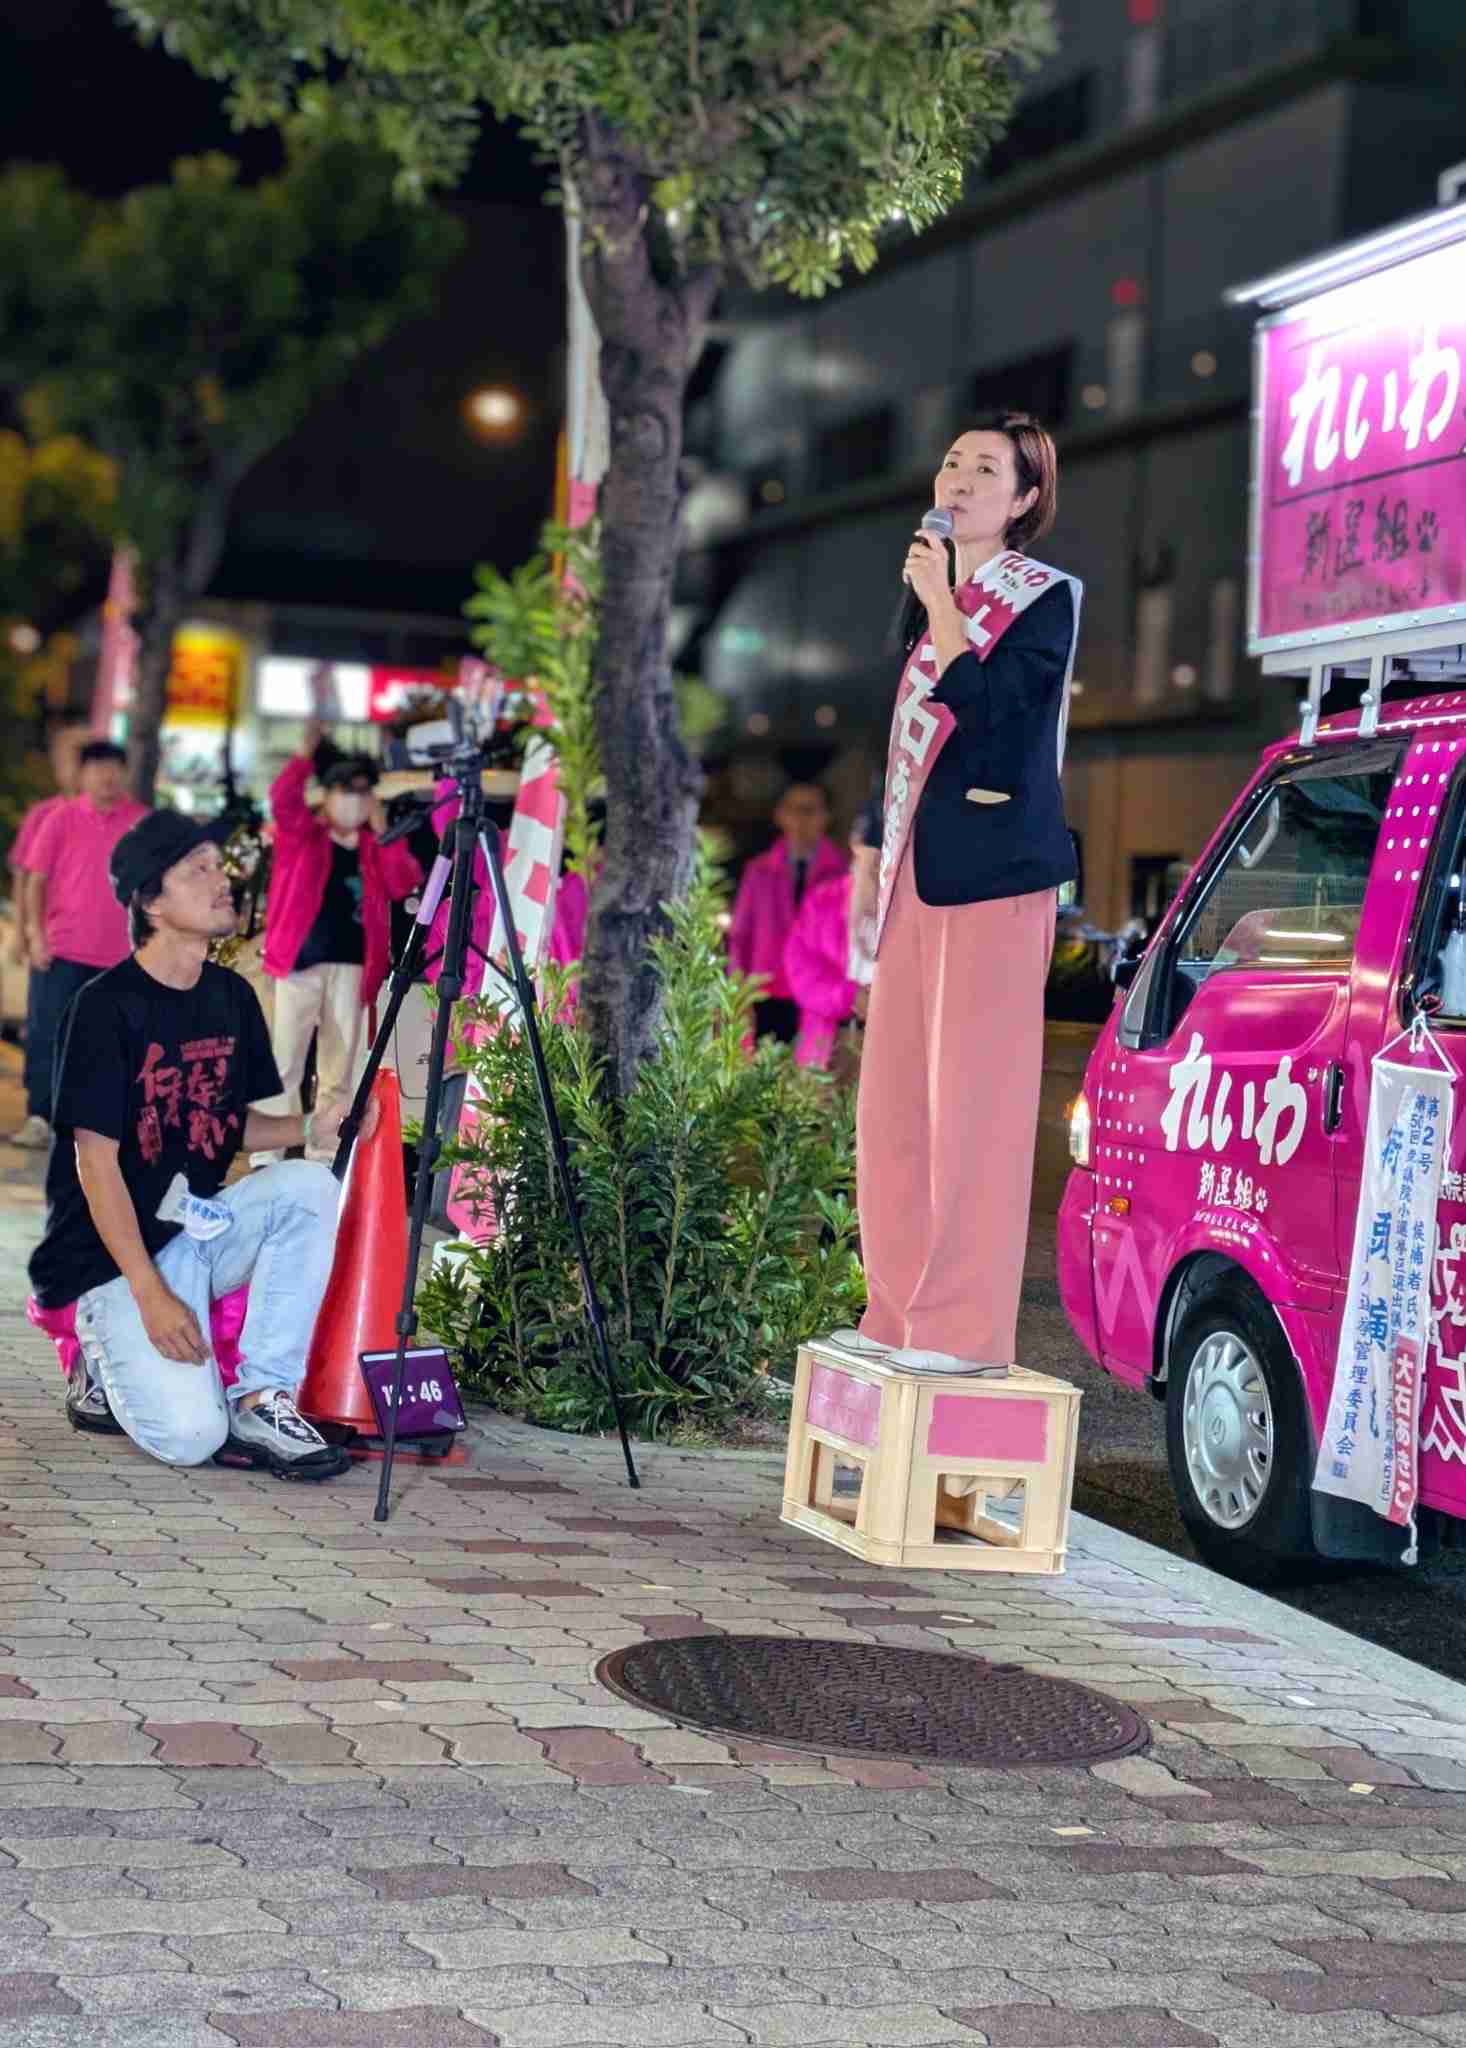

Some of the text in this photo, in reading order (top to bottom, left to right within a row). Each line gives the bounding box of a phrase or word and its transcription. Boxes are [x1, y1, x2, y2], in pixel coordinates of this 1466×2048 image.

[1281, 328, 1460, 488] れいわ
[1000, 554, 1051, 588] れいわ
[1160, 1032, 1307, 1166] れいわ
